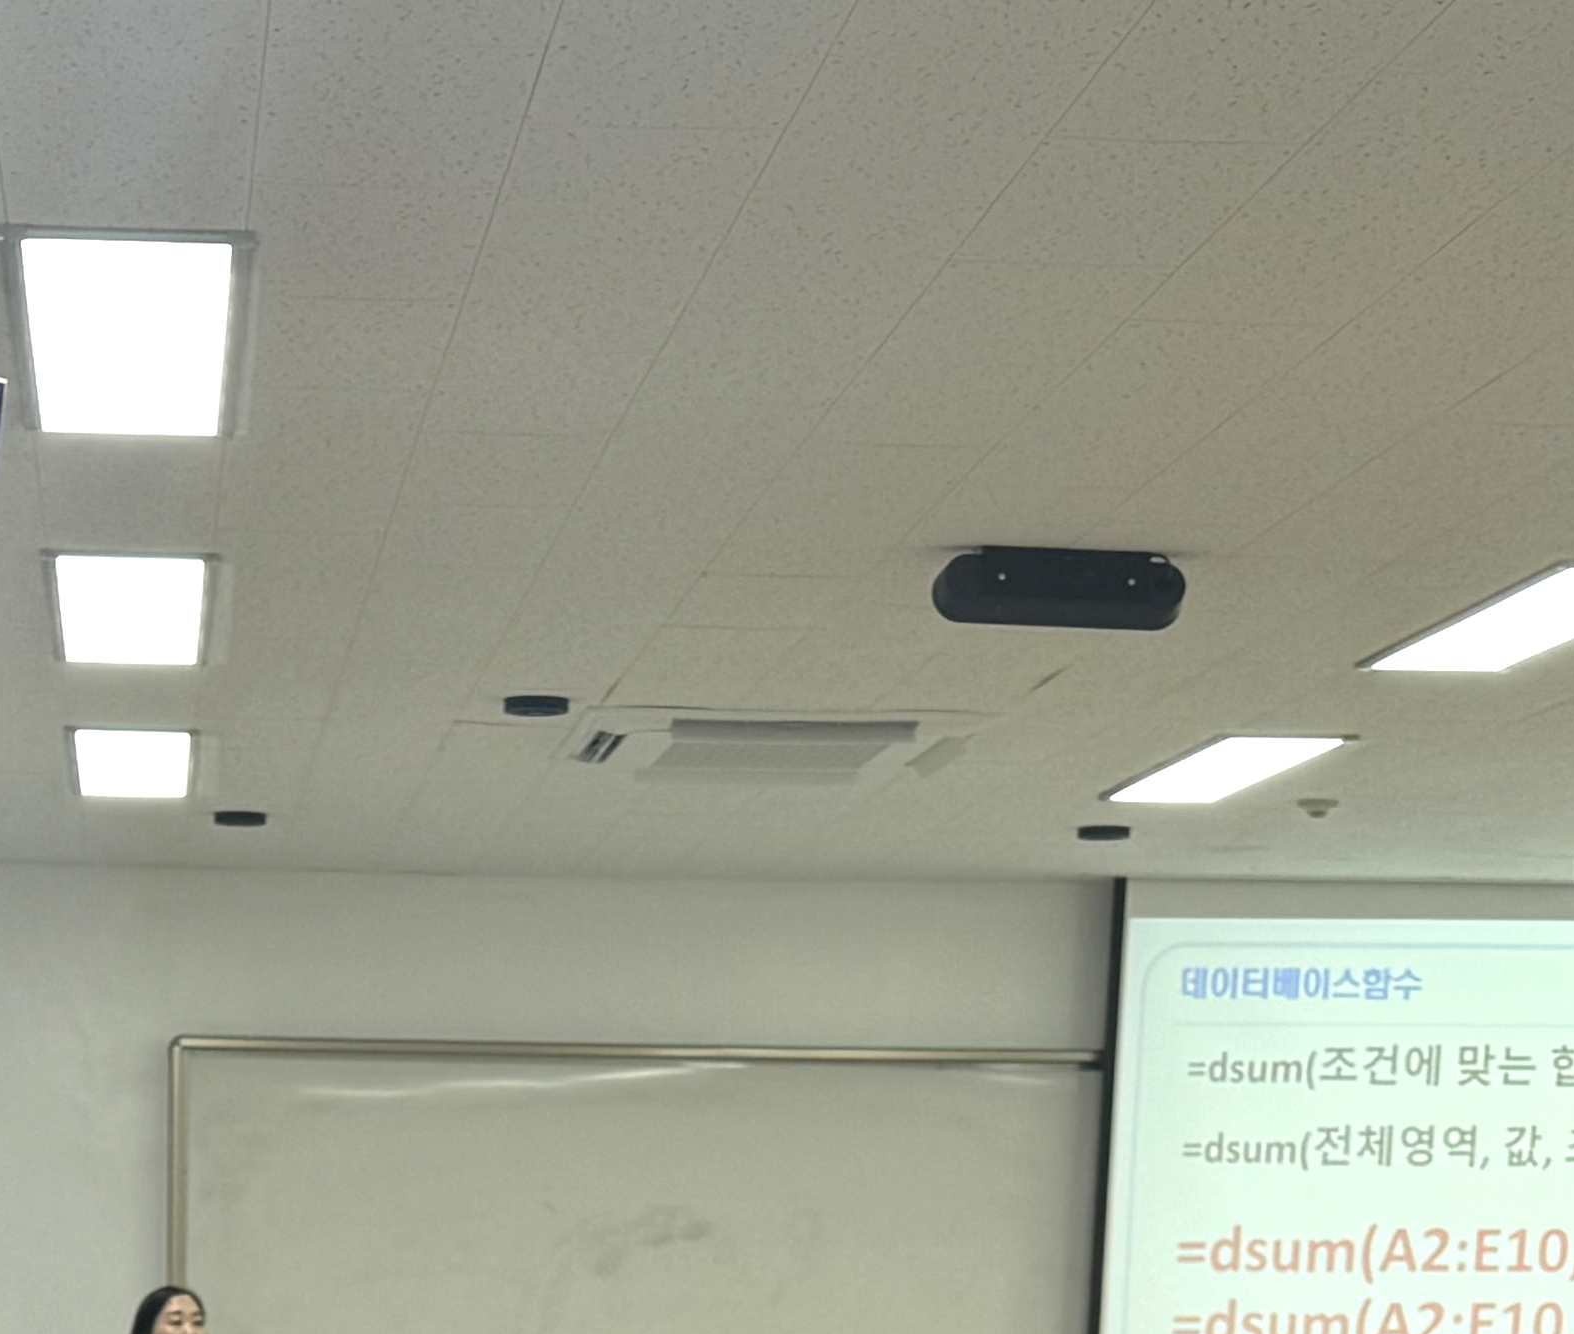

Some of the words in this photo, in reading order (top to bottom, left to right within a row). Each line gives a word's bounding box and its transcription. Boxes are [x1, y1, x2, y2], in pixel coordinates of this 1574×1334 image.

[1181, 965, 1423, 1003] 데이터베이스함수
[1187, 1045, 1442, 1093] =dsum(조건에
[1457, 1045, 1537, 1087] 맞는
[1183, 1125, 1491, 1172] =dsum(전체영역,
[1504, 1127, 1551, 1172] 값,
